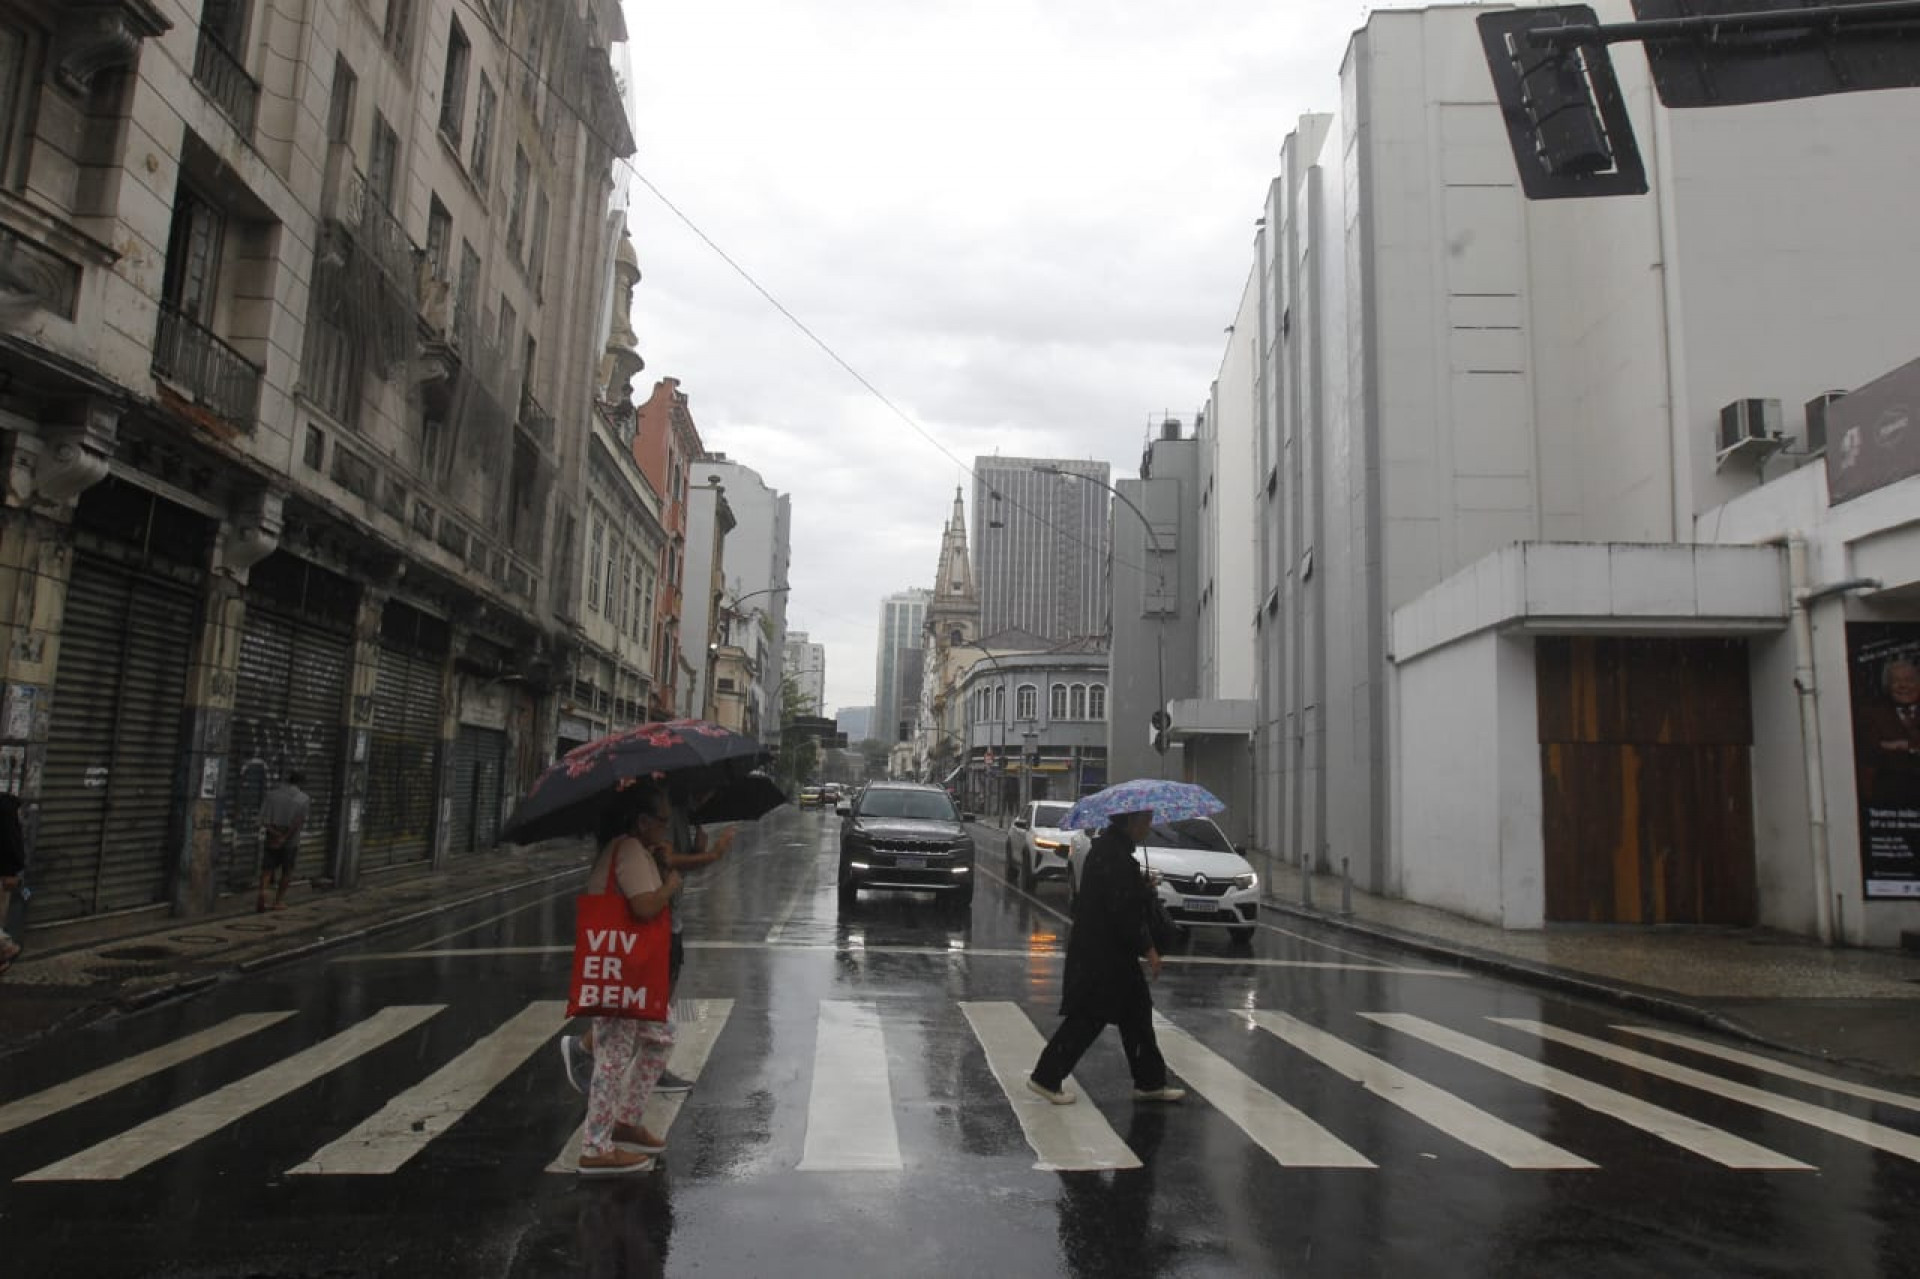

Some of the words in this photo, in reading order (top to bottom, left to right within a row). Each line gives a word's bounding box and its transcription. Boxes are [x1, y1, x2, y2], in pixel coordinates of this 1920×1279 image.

[586, 930, 638, 954] VIV
[583, 956, 622, 980] ER
[579, 985, 647, 1009] BEM
